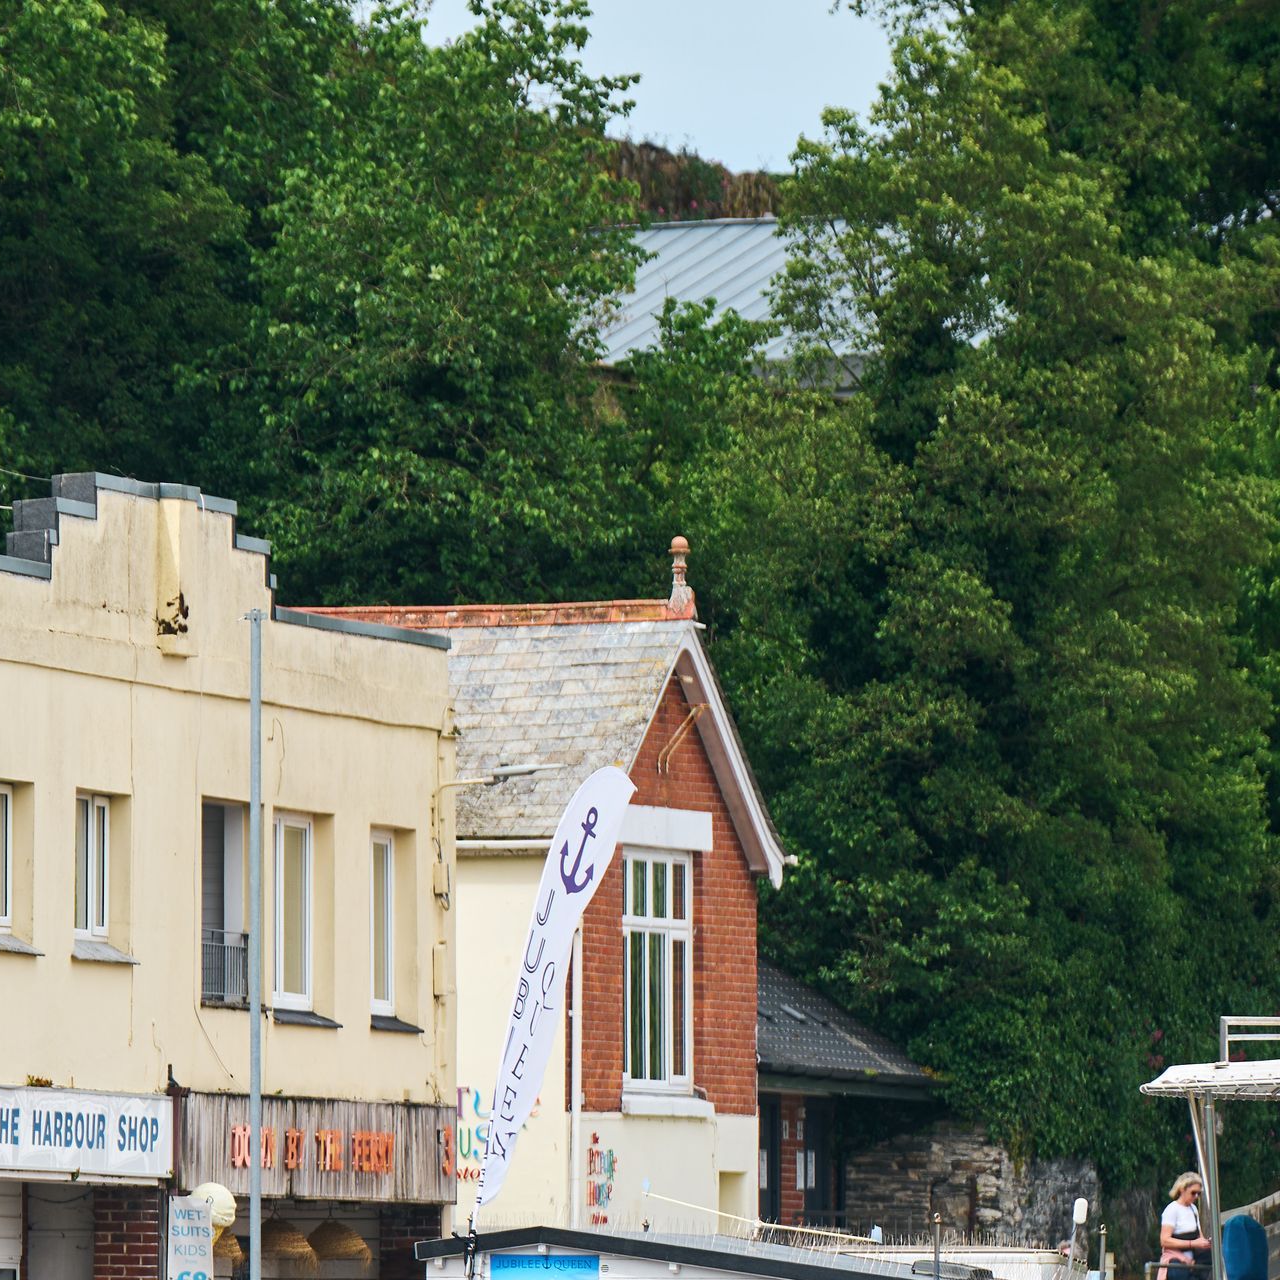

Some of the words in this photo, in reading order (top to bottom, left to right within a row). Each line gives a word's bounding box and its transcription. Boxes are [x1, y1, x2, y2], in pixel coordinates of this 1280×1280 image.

[32, 1109, 106, 1149] HARBOUR
[117, 1114, 159, 1153] SHOP
[284, 1127, 305, 1169] BY
[315, 1129, 344, 1172] THE
[351, 1130, 395, 1174] FERRY
[174, 1208, 206, 1220] WET-
[172, 1225, 210, 1237] SUITS
[174, 1244, 207, 1256] KIDS
[496, 1259, 540, 1269] JUBILEE
[553, 1259, 593, 1271] QUEEN
